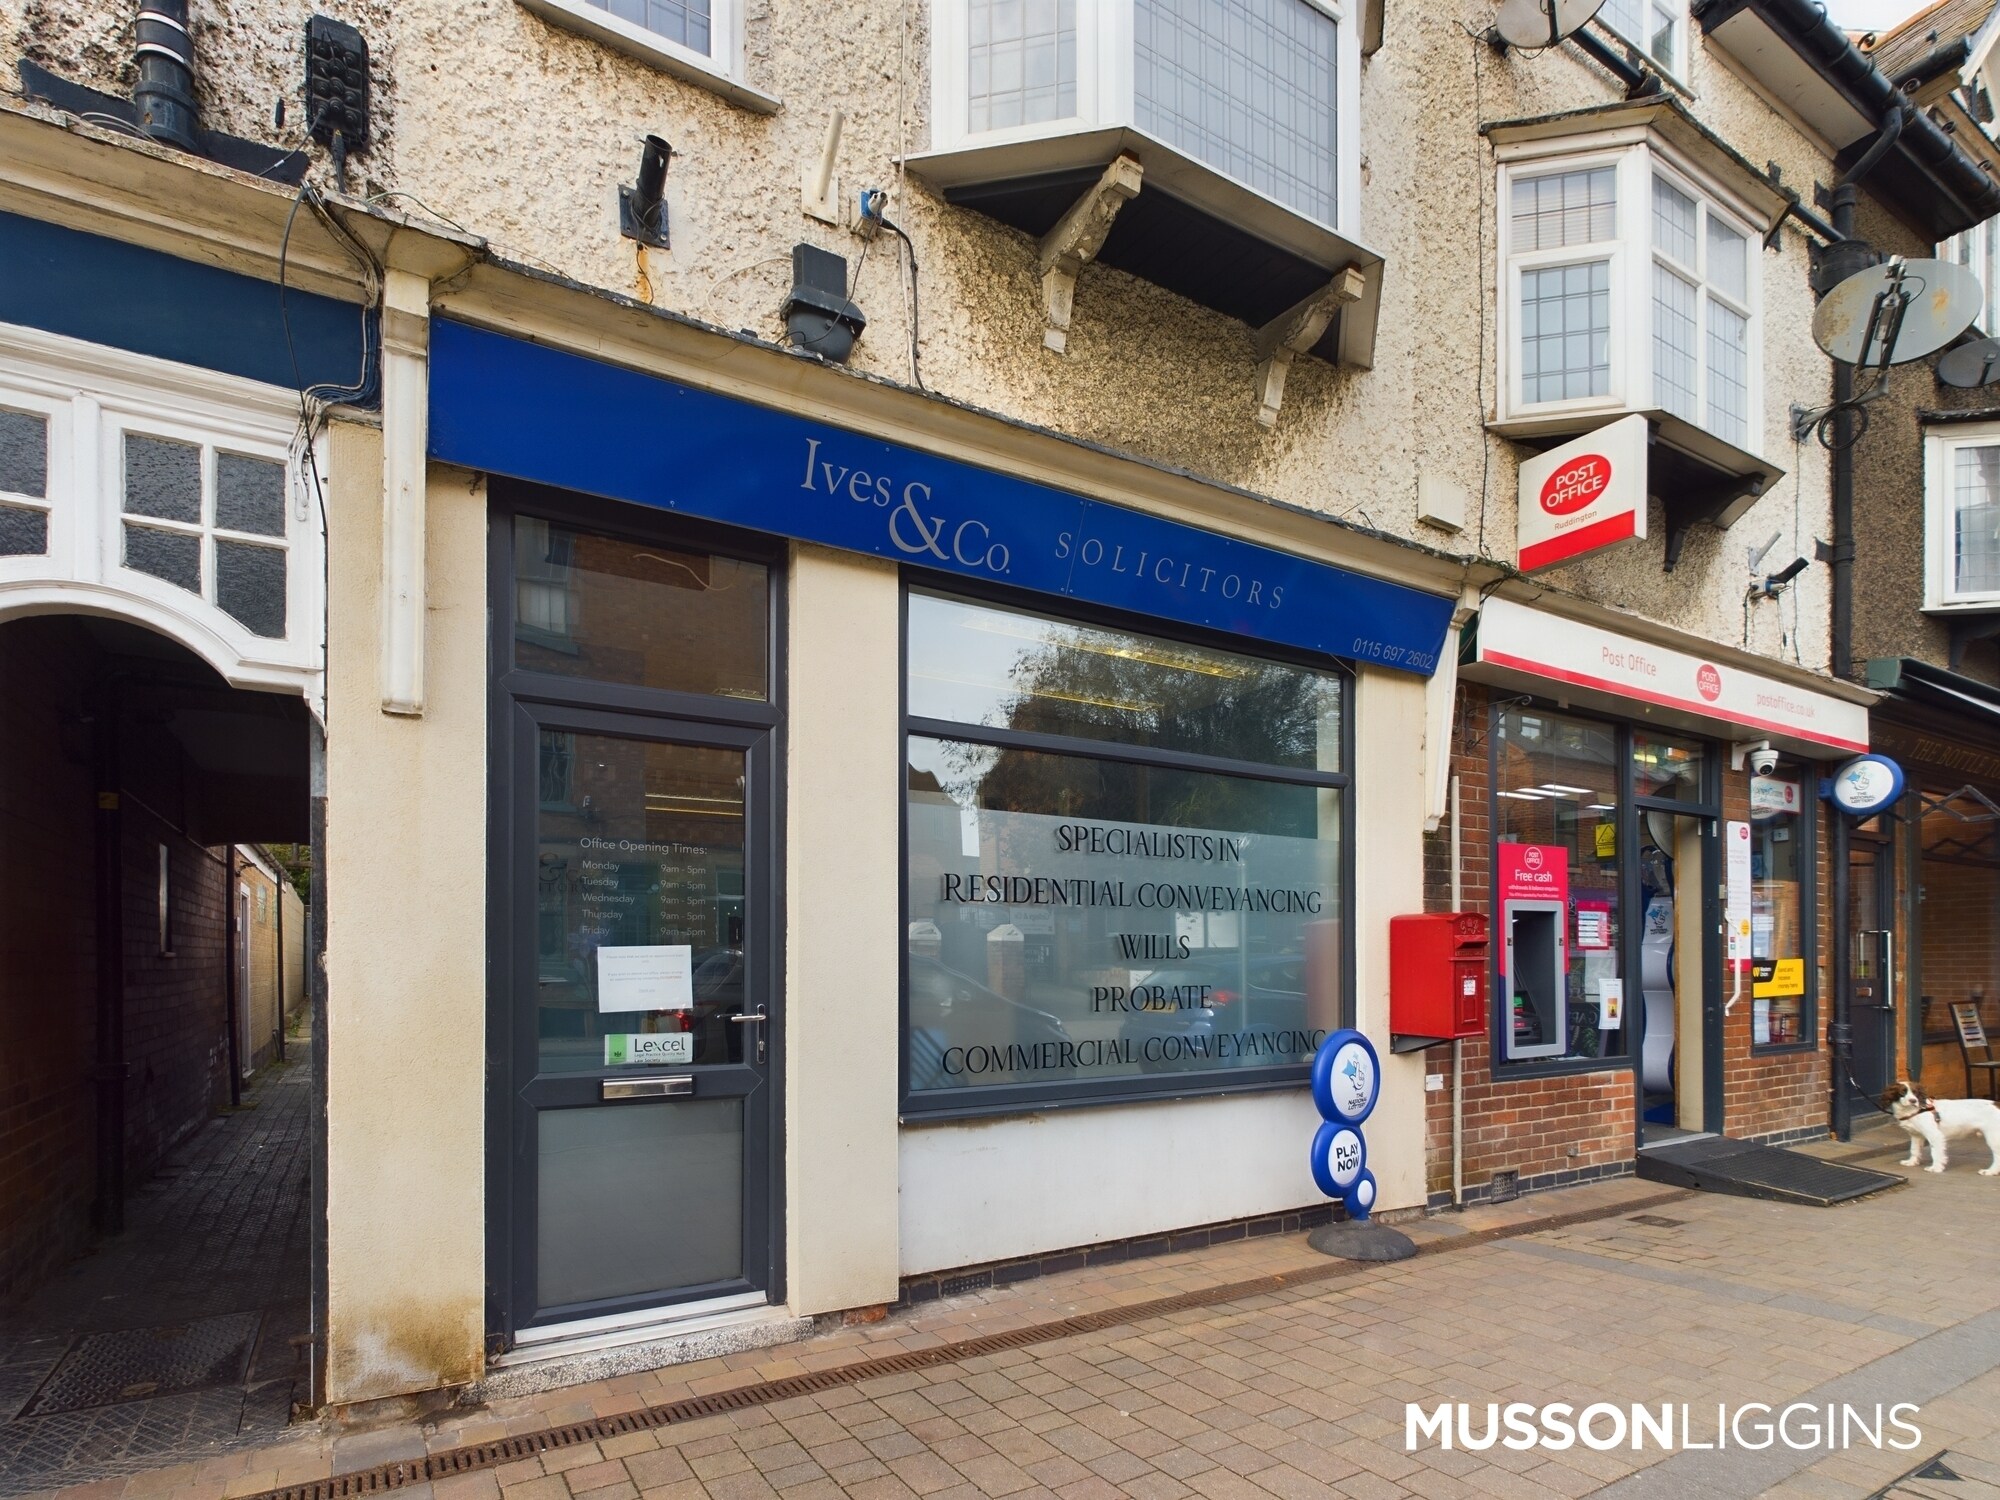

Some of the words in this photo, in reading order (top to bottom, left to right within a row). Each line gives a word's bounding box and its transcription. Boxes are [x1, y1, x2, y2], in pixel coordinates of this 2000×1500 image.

[1556, 461, 1598, 490] POST
[802, 438, 891, 507] Ives
[889, 482, 949, 560] &
[1546, 475, 1603, 508] OFFICE
[1554, 510, 1598, 530] Ruddington
[1056, 531, 1285, 609] SOLICITORS
[1353, 638, 1382, 657] 0115
[1383, 645, 1405, 662] 697
[1406, 650, 1434, 669] 2602
[1602, 646, 1625, 668] Post
[1628, 653, 1657, 676] Office
[1701, 670, 1717, 683] POST
[1698, 680, 1719, 694] OFFICE
[1756, 693, 1816, 718] postoffice.co.uk
[580, 837, 616, 850] Office
[619, 840, 669, 855] Opening
[672, 843, 708, 855] Times:
[1059, 824, 1214, 861] SPECIALISTS
[1219, 839, 1240, 863] IN
[582, 860, 620, 873] Monday
[660, 864, 679, 873] 9am
[687, 865, 707, 875] 5pm
[1515, 869, 1533, 881] Free
[1534, 871, 1553, 882] cash
[581, 876, 619, 889] Tuesday
[660, 880, 679, 889] 9am
[687, 881, 707, 891] 5pm
[944, 873, 1133, 908] RESIDENTIAL
[1138, 882, 1322, 914] CONVEYANCING
[582, 893, 636, 905] Wednesday
[660, 896, 679, 905] 9am
[687, 896, 707, 906] 5pm
[582, 909, 624, 921] Thursday
[660, 911, 679, 920] 9am
[687, 912, 707, 921] 5pm
[582, 926, 610, 936] Friday
[660, 927, 679, 936] 9am
[687, 927, 707, 937] 5pm
[1120, 934, 1190, 960] WILLS
[1093, 985, 1212, 1013] PROBATE
[634, 1037, 686, 1053] Lexcel
[942, 1038, 1138, 1076] COMMERCIAL
[1336, 1143, 1359, 1159] PLAY
[1337, 1156, 1360, 1172] NOW
